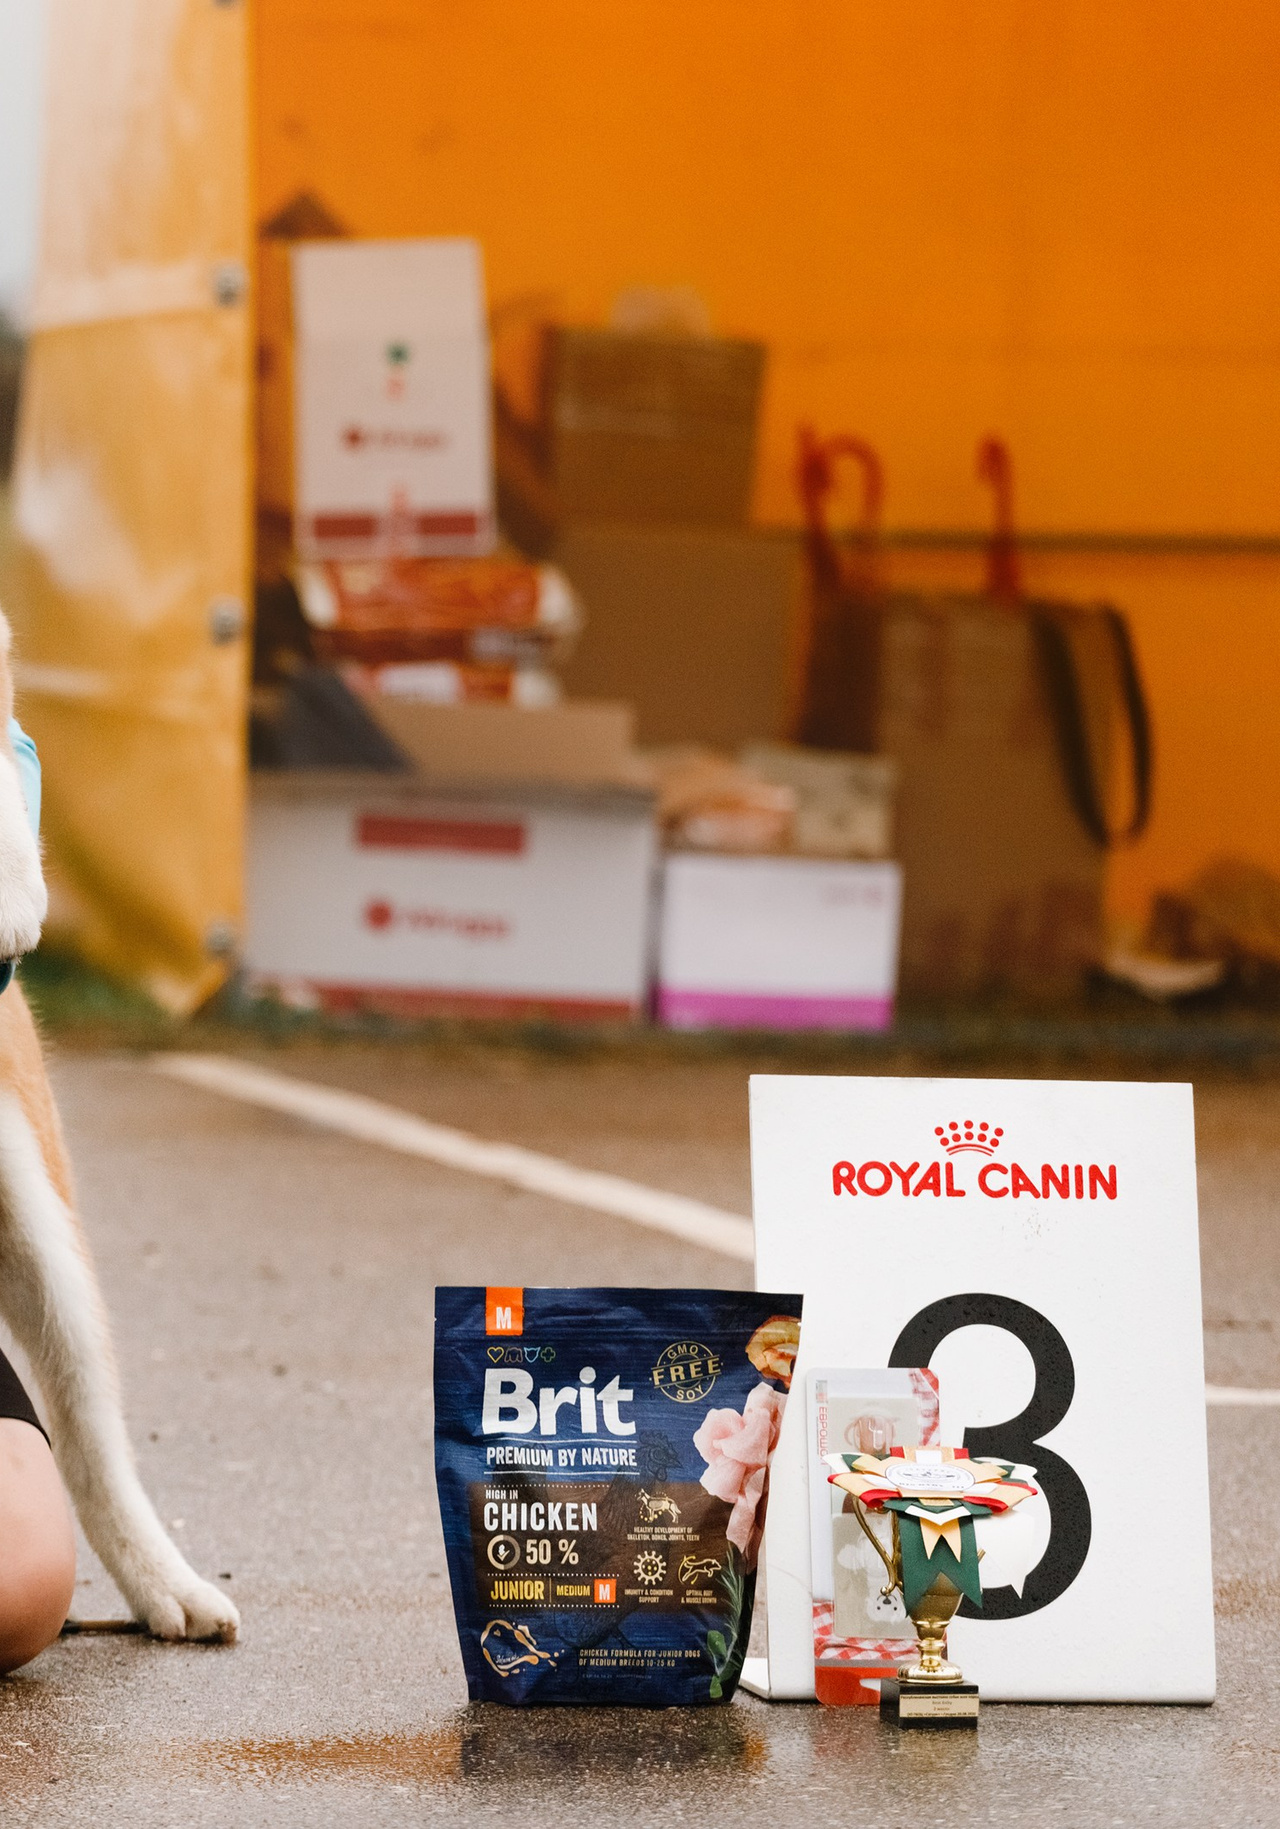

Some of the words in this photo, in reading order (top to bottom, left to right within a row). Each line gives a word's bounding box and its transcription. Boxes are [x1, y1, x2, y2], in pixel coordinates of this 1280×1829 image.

[832, 1161, 966, 1198] ROYAL
[979, 1162, 1118, 1200] CANIN
[496, 1306, 512, 1330] M
[667, 1344, 699, 1359] GMO
[652, 1357, 721, 1386] FREE
[481, 1366, 636, 1436] Brit
[676, 1384, 704, 1400] SOY
[819, 1407, 828, 1466] ЕВРОШО
[486, 1447, 554, 1466] PREMIUM
[558, 1448, 577, 1467] BY
[582, 1447, 638, 1467] NATURE
[888, 1292, 1092, 1620] 3
[485, 1489, 507, 1500] HIGH
[509, 1489, 519, 1500] IN
[483, 1502, 598, 1532] CHICKEN
[525, 1538, 552, 1565] 50
[558, 1538, 579, 1565] %
[490, 1580, 545, 1601] JUNIOR
[556, 1585, 591, 1597] MEDIUM
[598, 1583, 611, 1601] M
[578, 1658, 587, 1666] OF
[589, 1658, 617, 1667] MEDIUM
[619, 1659, 645, 1667] BREEDS
[646, 1659, 665, 1667] 10-25
[579, 1649, 608, 1657] CHICKEN
[610, 1649, 642, 1657] FORMULA
[643, 1649, 656, 1658] FOR
[658, 1650, 683, 1658] JUNIOR
[684, 1650, 701, 1658] DOGS
